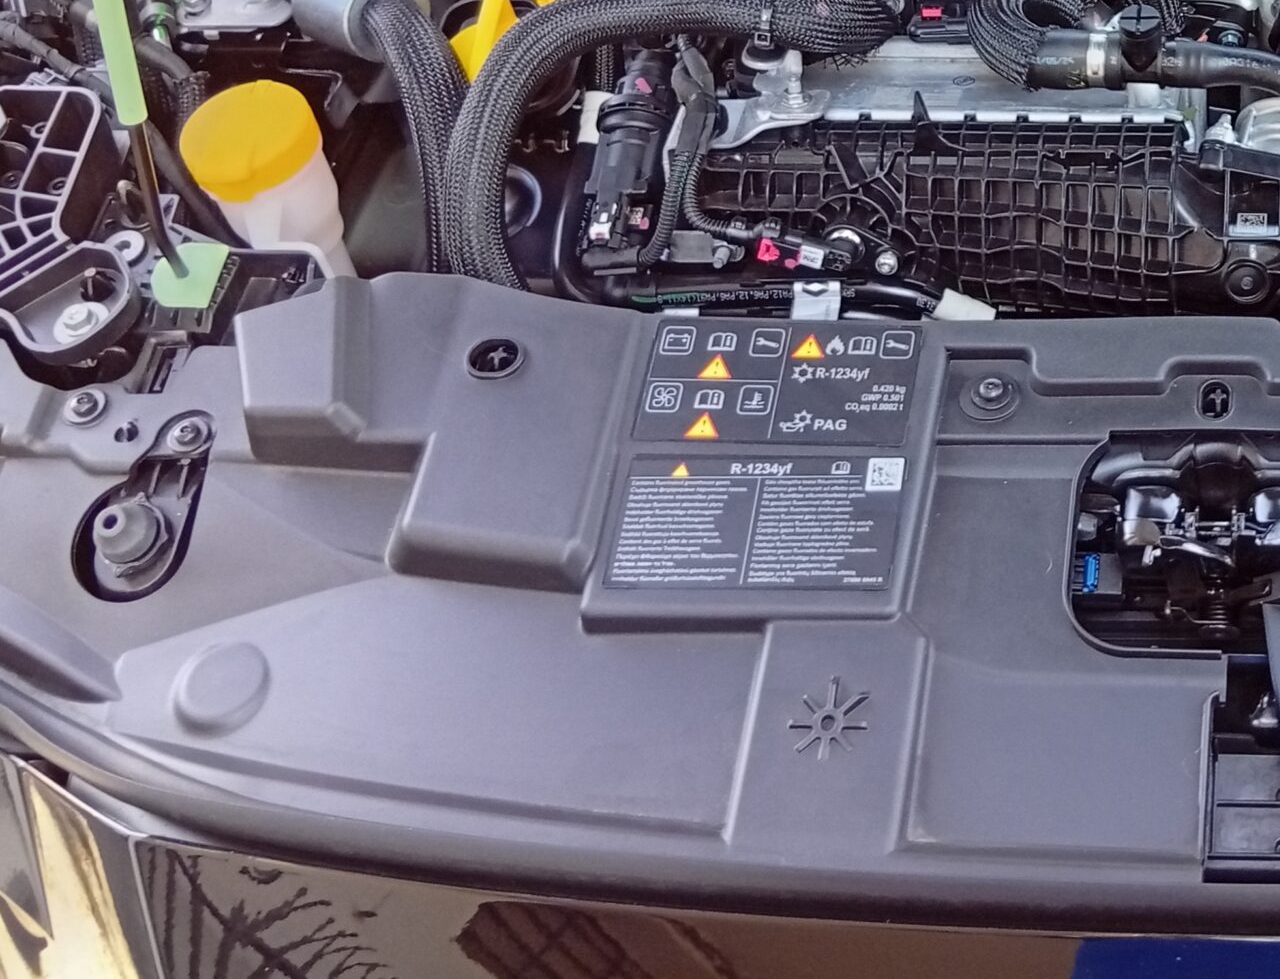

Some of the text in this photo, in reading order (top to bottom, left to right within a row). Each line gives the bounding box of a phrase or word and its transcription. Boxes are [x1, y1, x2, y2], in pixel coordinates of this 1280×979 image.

[815, 367, 871, 382] R-1234yf
[813, 419, 847, 430] PAG
[730, 462, 794, 477] R-1234yf
